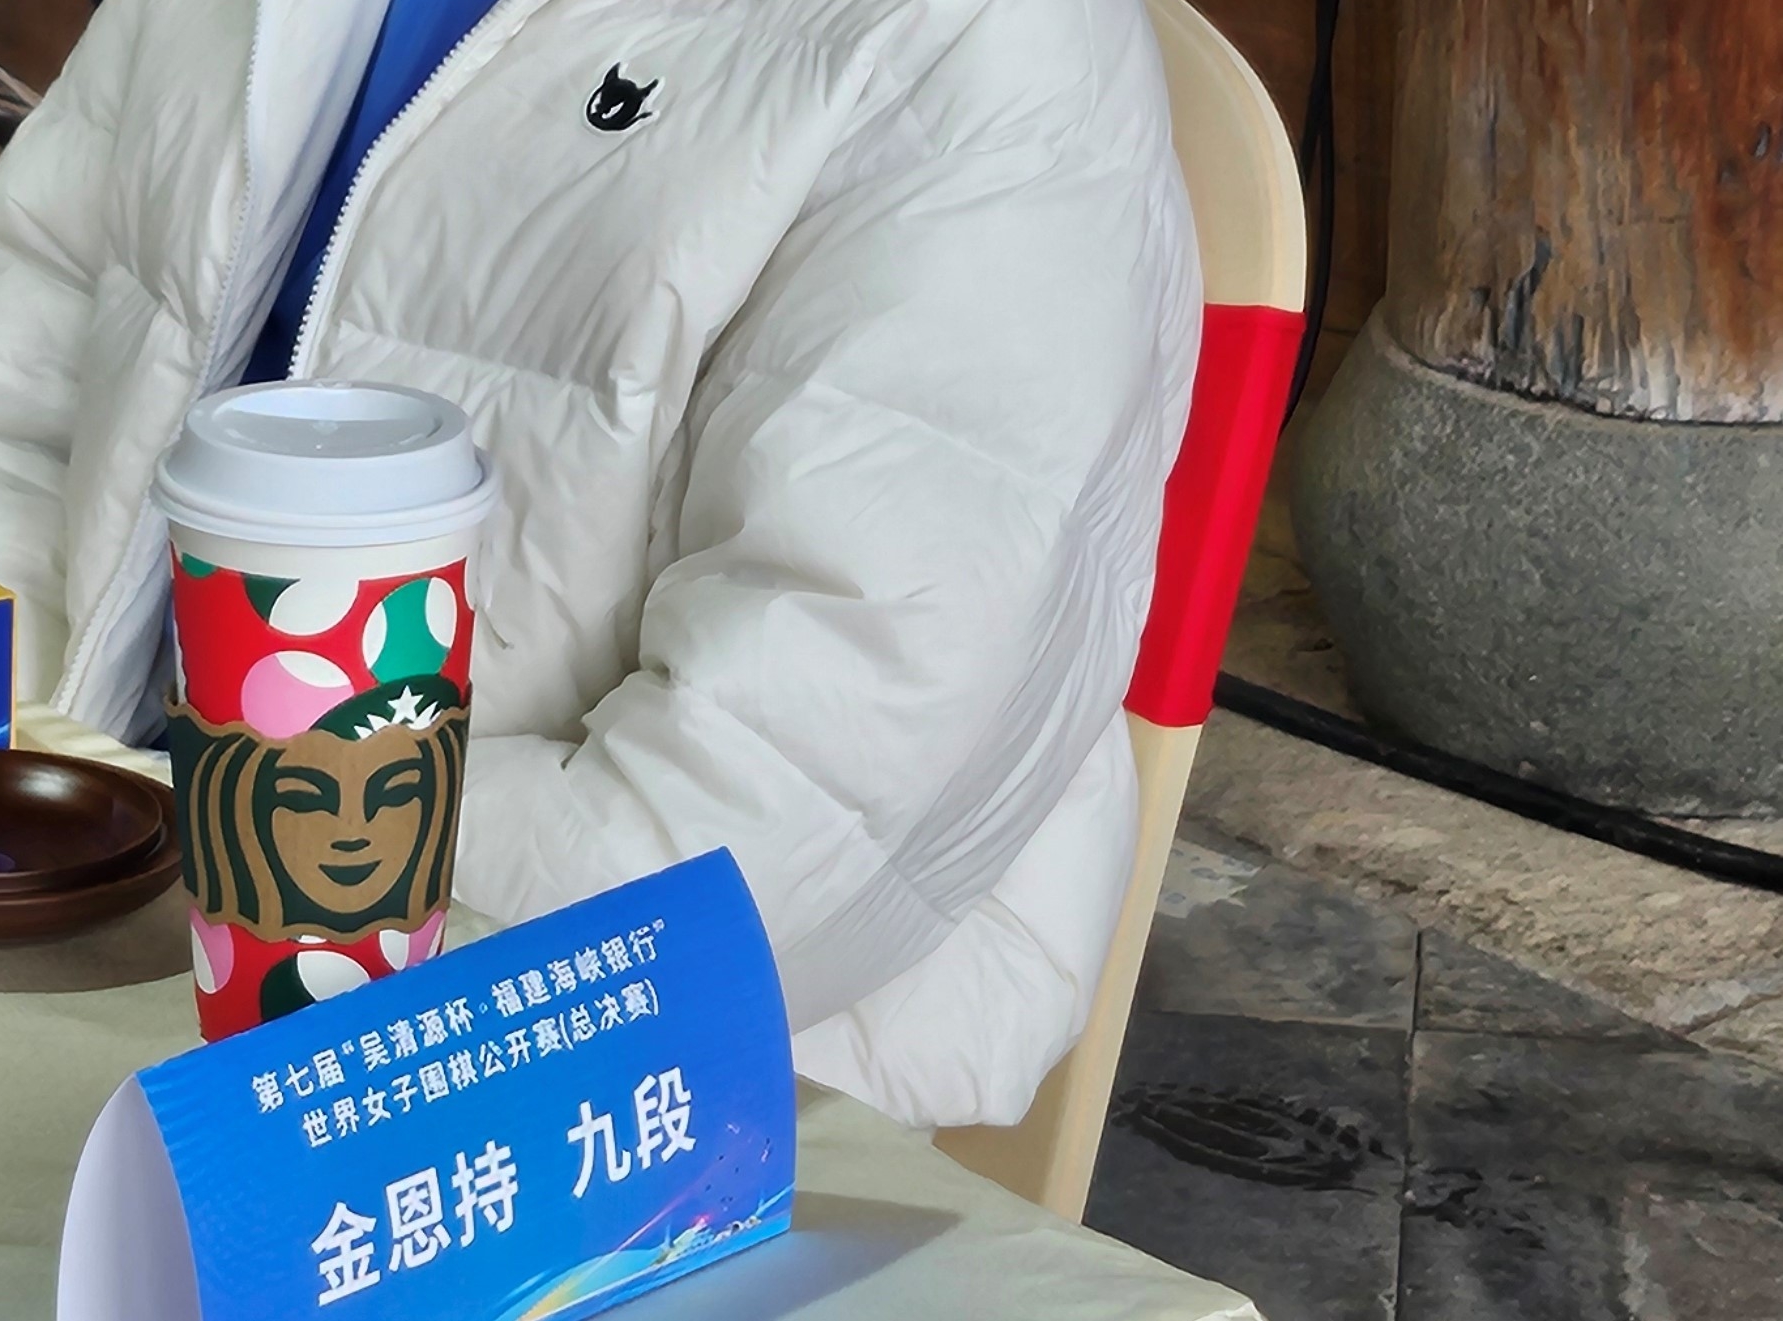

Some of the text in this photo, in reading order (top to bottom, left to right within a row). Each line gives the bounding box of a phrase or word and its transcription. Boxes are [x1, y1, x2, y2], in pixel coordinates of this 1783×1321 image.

[302, 978, 659, 1148] 世界女子围棋公开赛(总决赛)
[310, 1066, 697, 1307] 金恩持 九段
